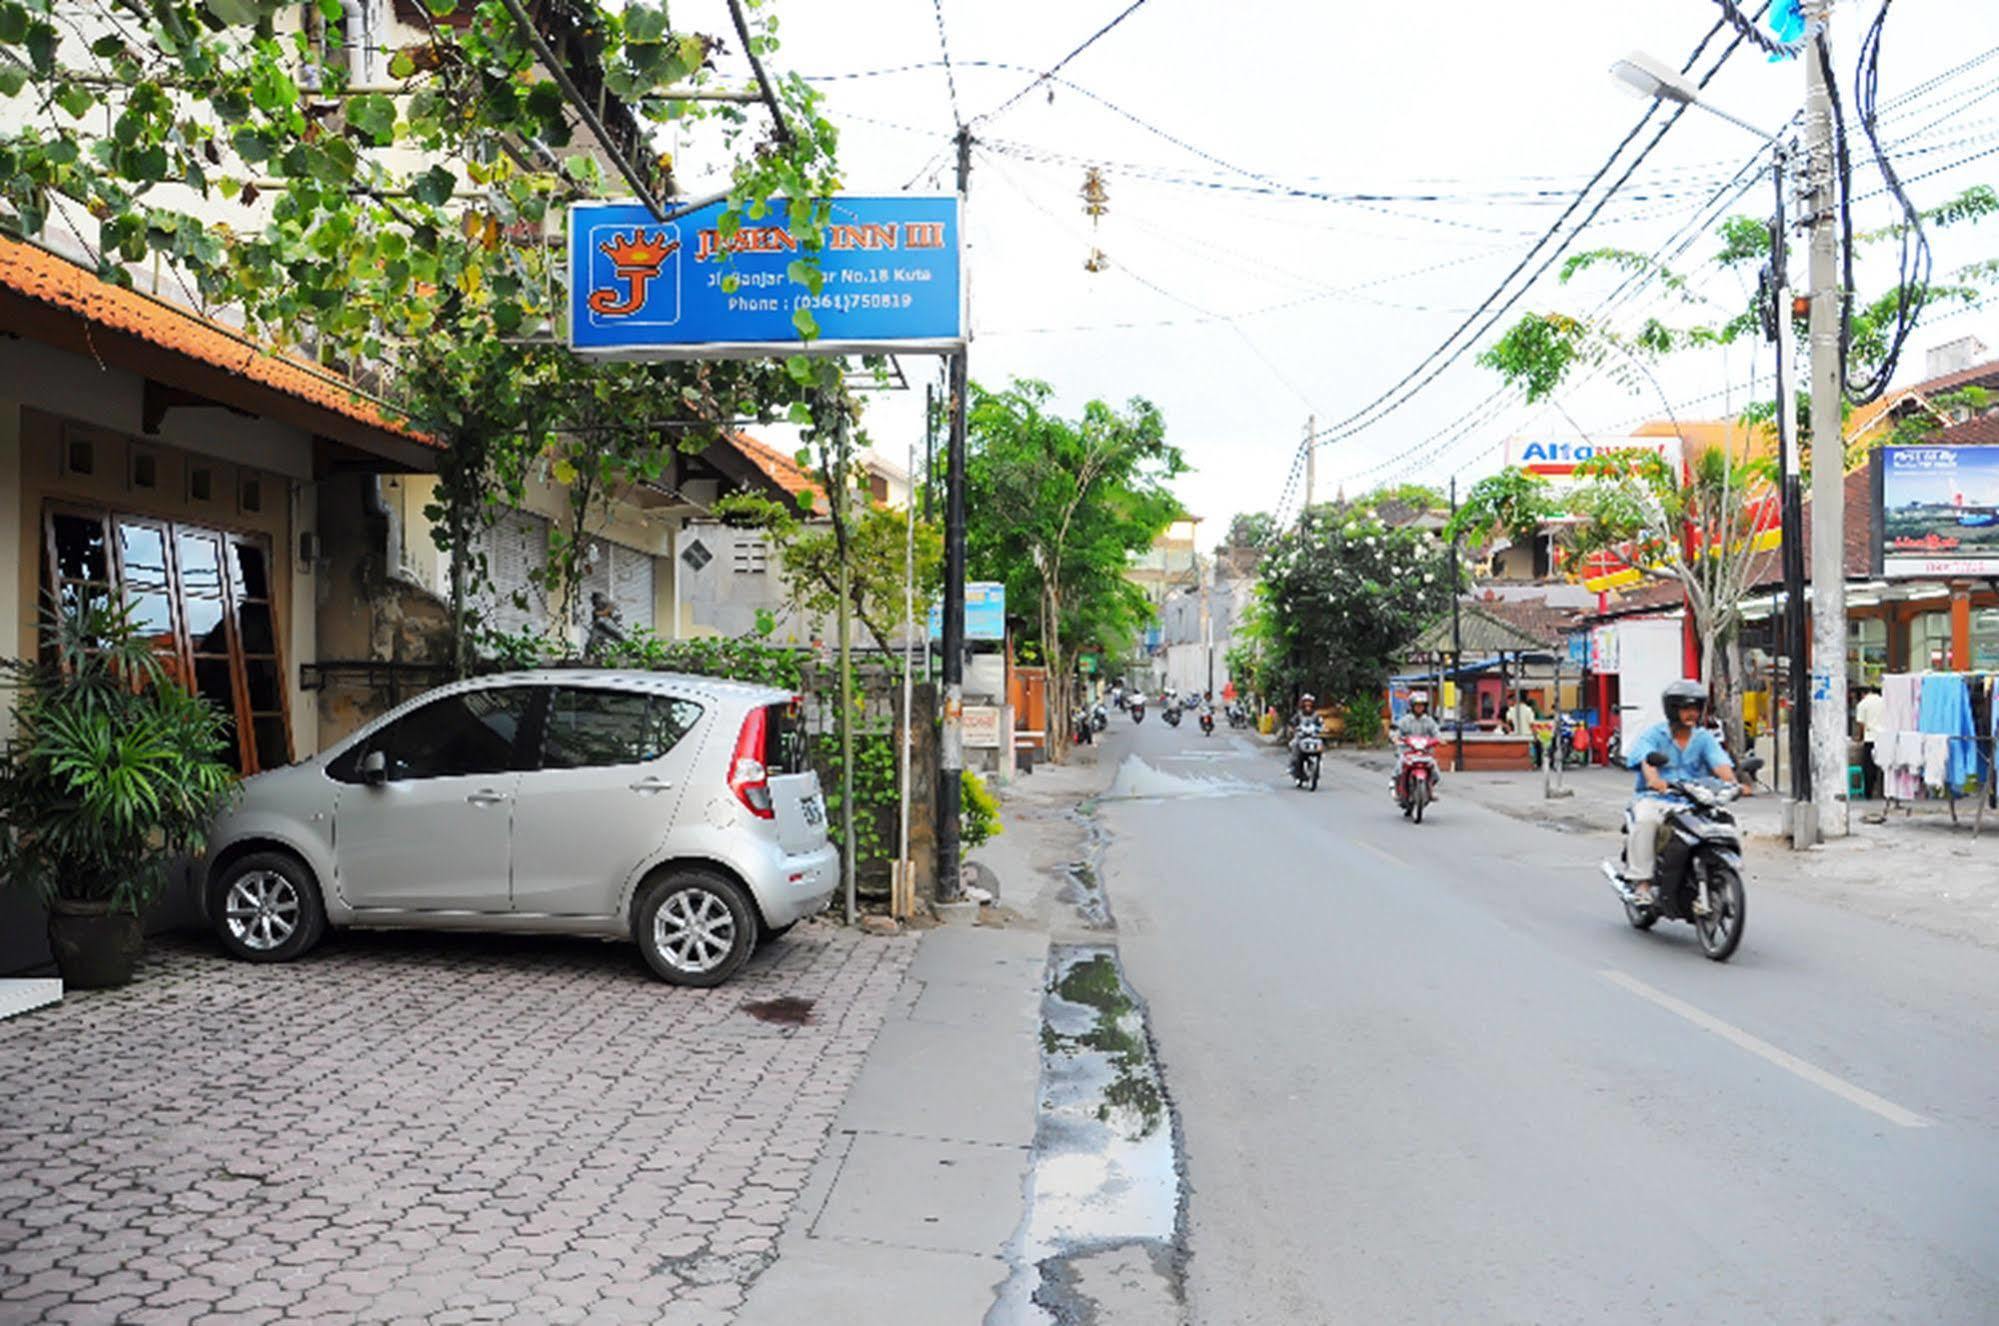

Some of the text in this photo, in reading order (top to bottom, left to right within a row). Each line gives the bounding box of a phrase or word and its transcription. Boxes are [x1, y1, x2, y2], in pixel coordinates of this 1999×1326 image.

[695, 221, 946, 263] JESEN INN III
[893, 266, 934, 282] Kuta
[728, 297, 779, 311] Phone
